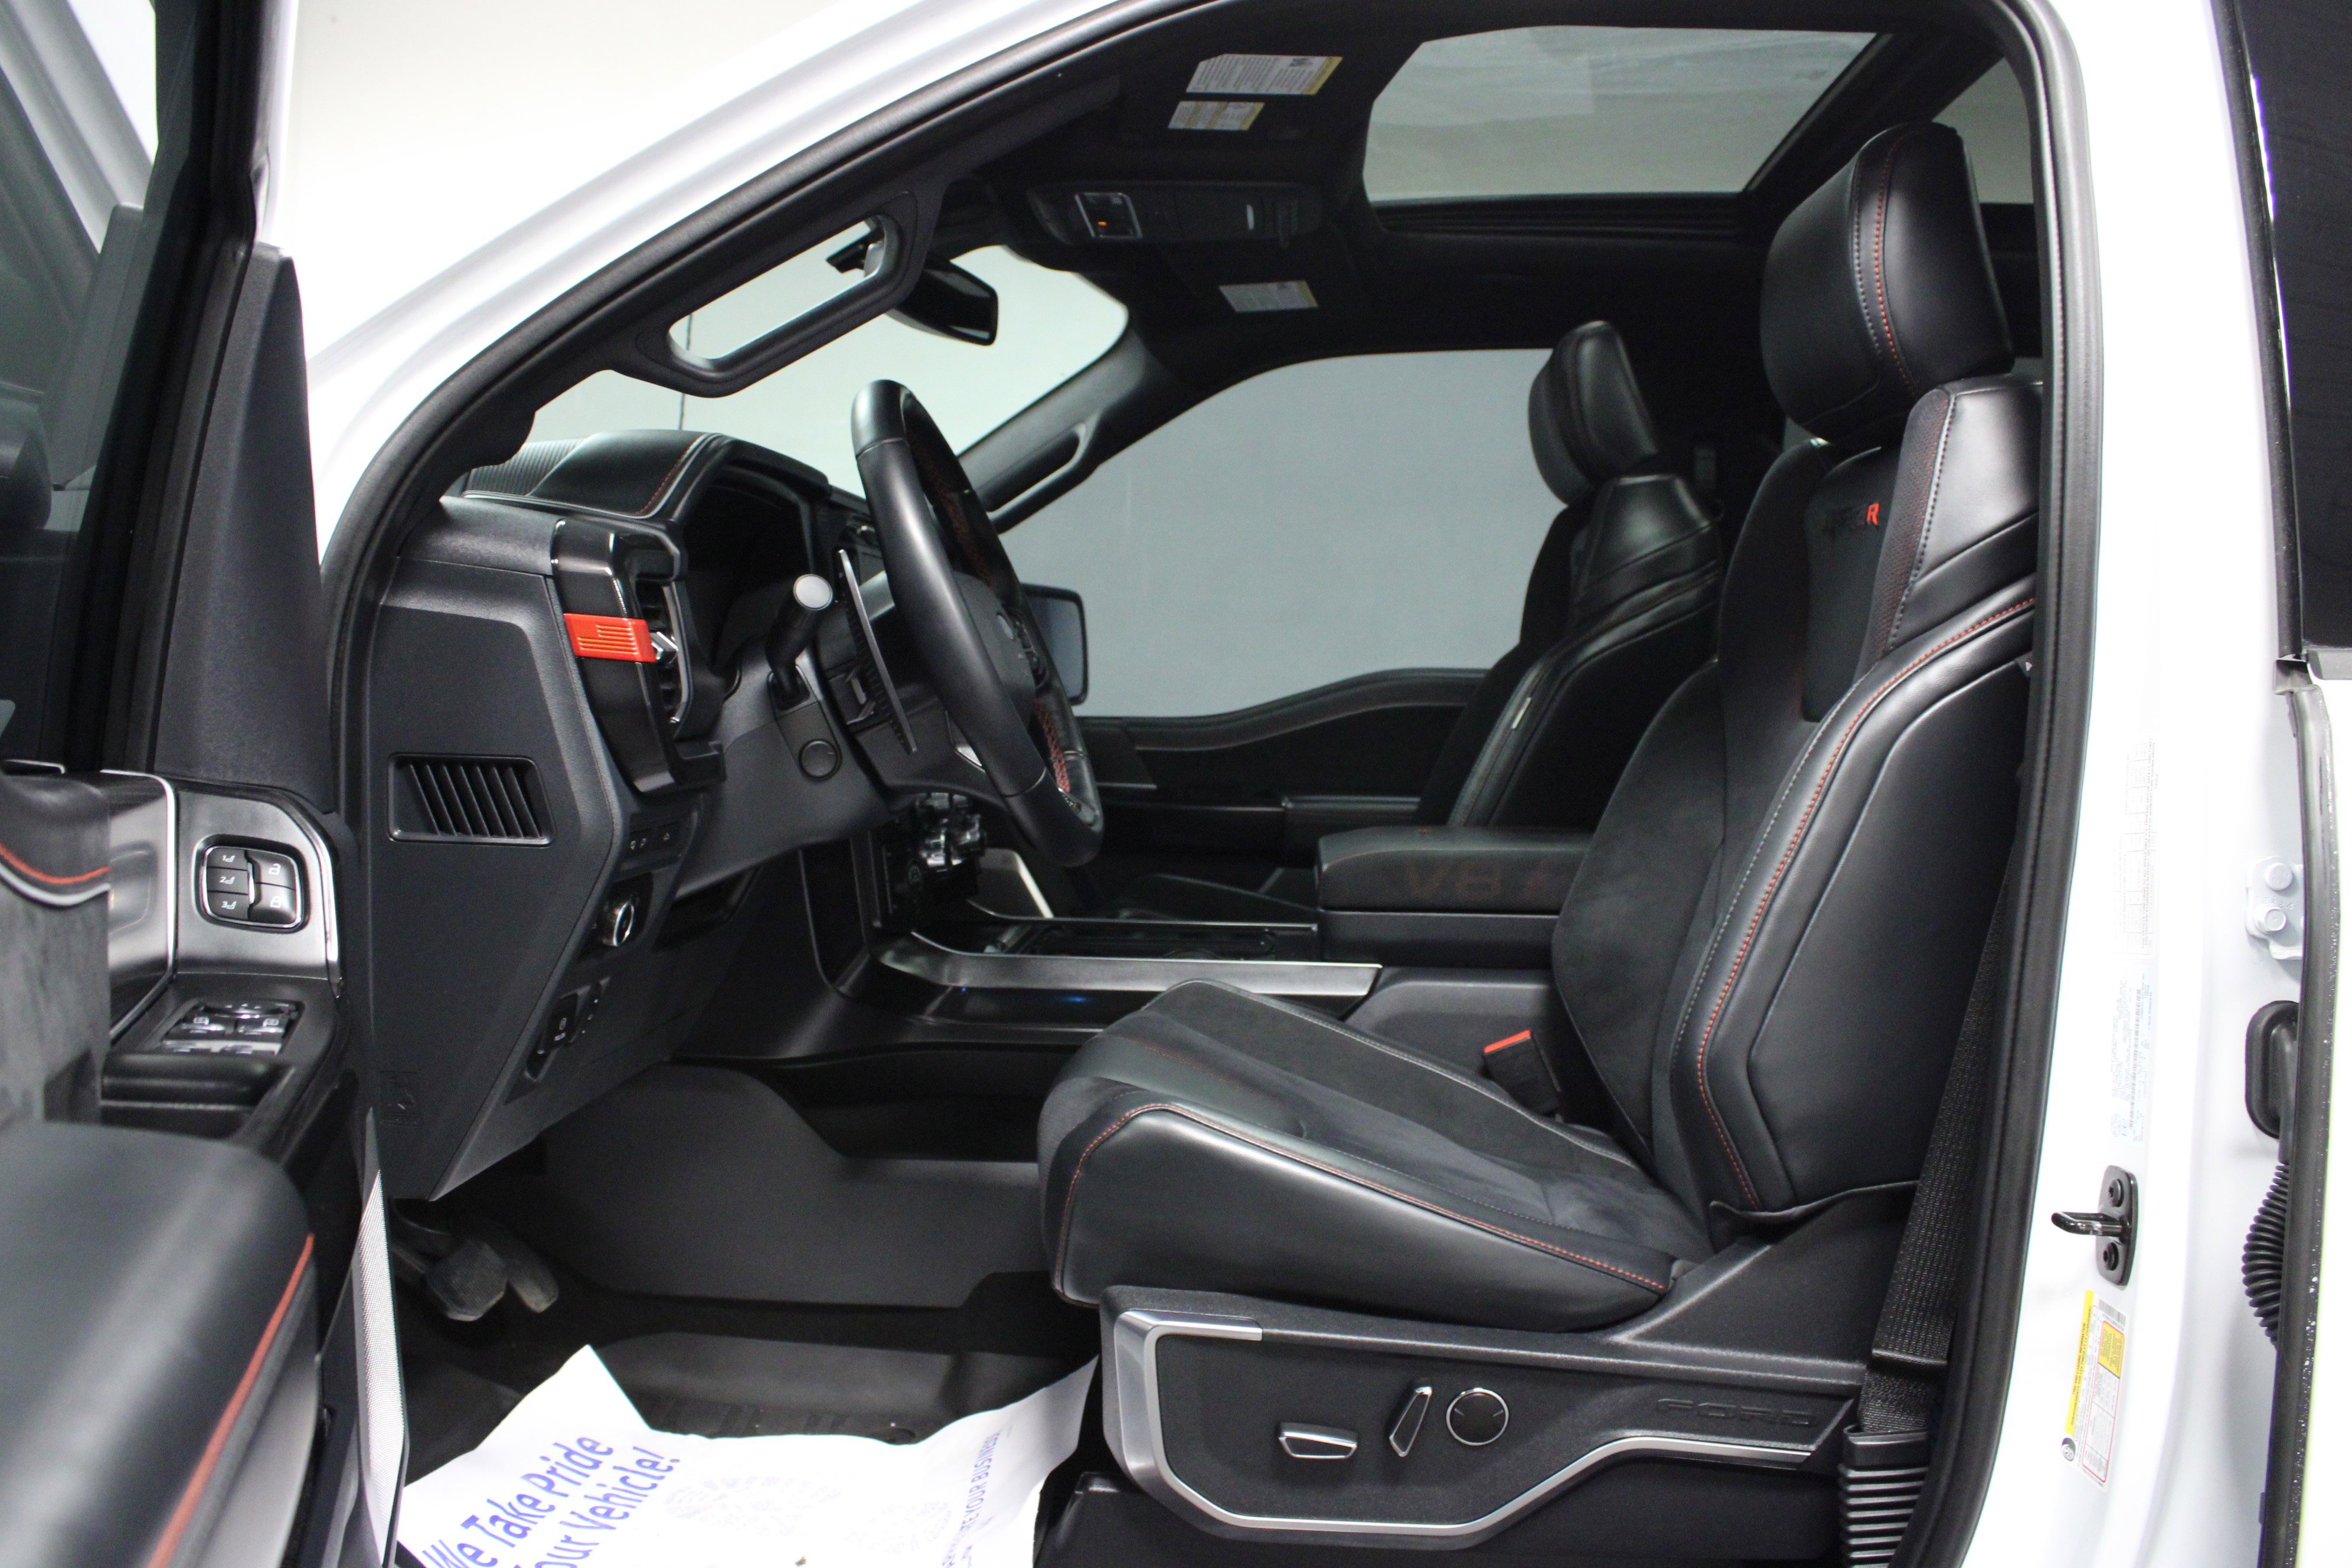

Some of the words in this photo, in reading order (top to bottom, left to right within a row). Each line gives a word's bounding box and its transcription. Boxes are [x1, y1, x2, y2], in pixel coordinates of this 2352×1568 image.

[1866, 502, 1880, 525] R
[1657, 1397, 1812, 1426] FORD
[521, 1436, 615, 1498] Pride
[513, 1535, 600, 1568] our
[560, 1446, 681, 1531] Vehicle!
[963, 1481, 987, 1518] YOUR
[460, 1493, 556, 1548] Take
[422, 1539, 499, 1568] We
